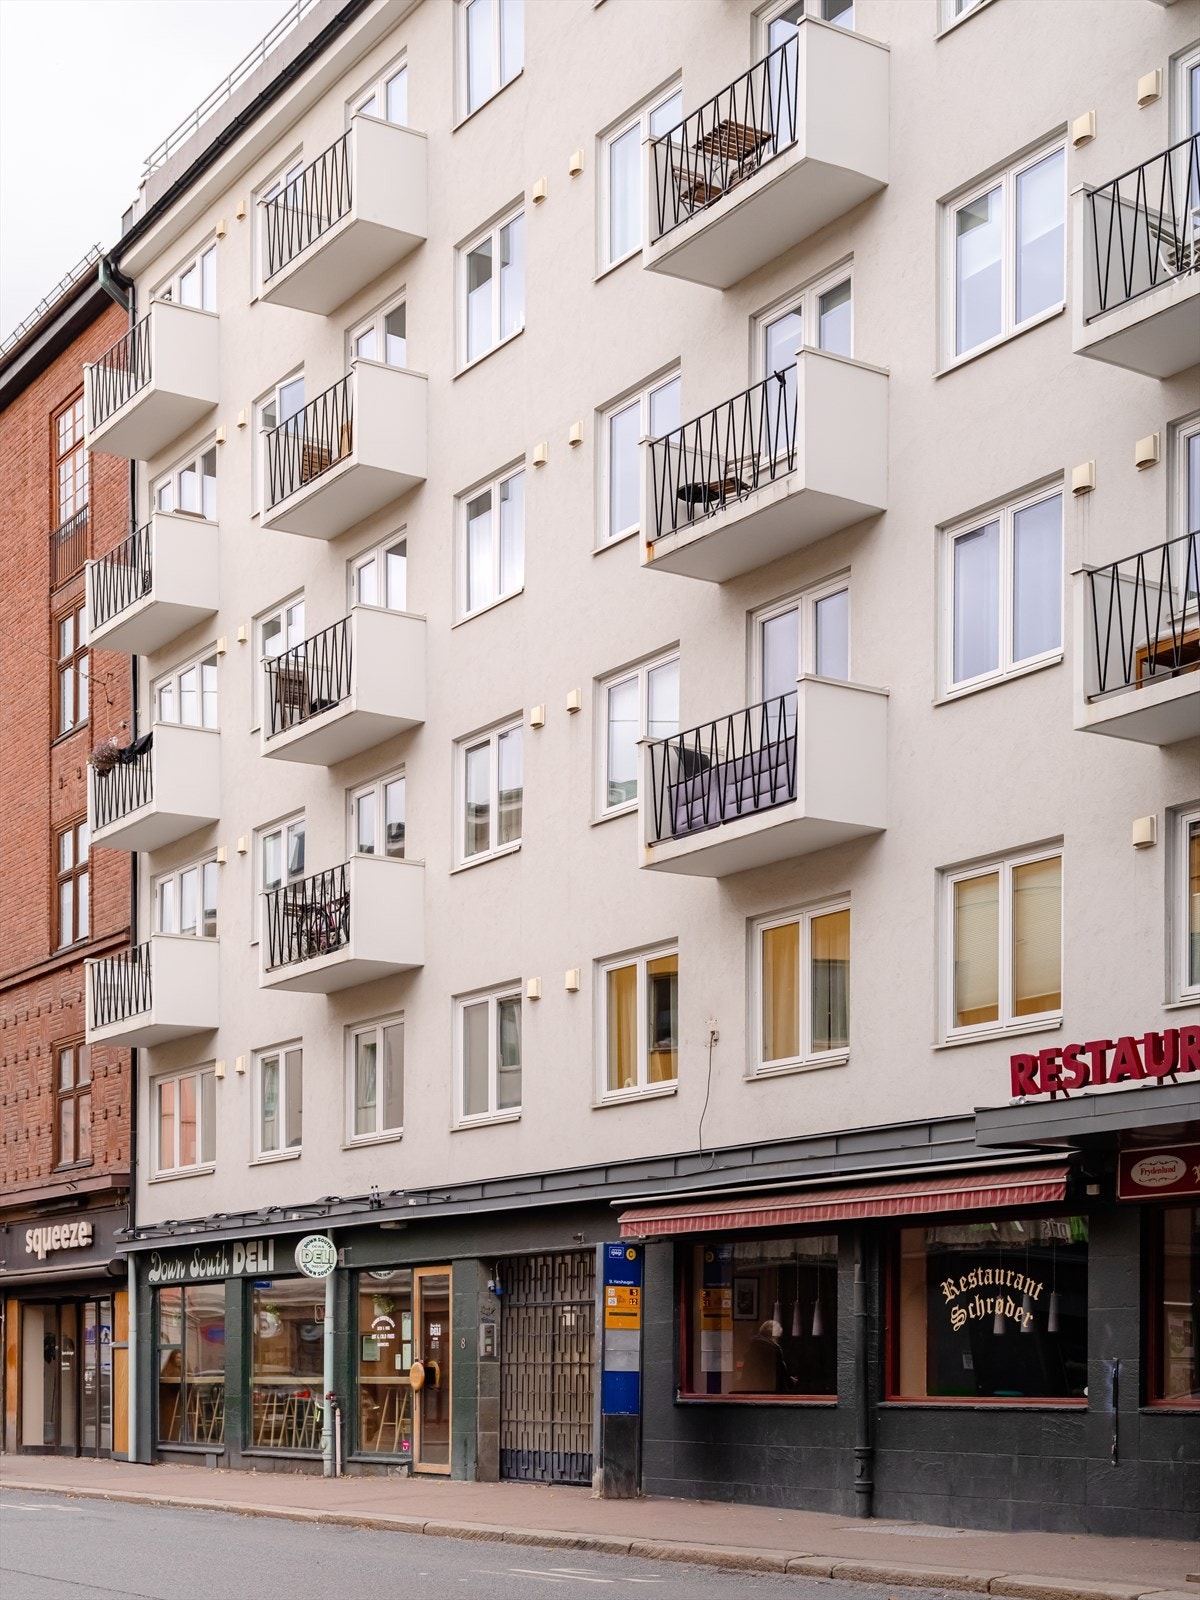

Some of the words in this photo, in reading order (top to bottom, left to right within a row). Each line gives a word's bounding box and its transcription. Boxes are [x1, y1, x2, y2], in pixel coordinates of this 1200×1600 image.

[1140, 1165, 1176, 1176] Frydenlund
[25, 1221, 93, 1260] squeeze
[317, 1237, 333, 1249] SOUTH
[148, 1251, 186, 1282] Down
[189, 1247, 230, 1278] South
[232, 1239, 274, 1275] DELI
[301, 1248, 335, 1265] DELI
[317, 1264, 333, 1277] SOUTH
[939, 1266, 1044, 1304] Restaurant
[950, 1294, 1034, 1332] Schrøder
[460, 1337, 466, 1349] 8
